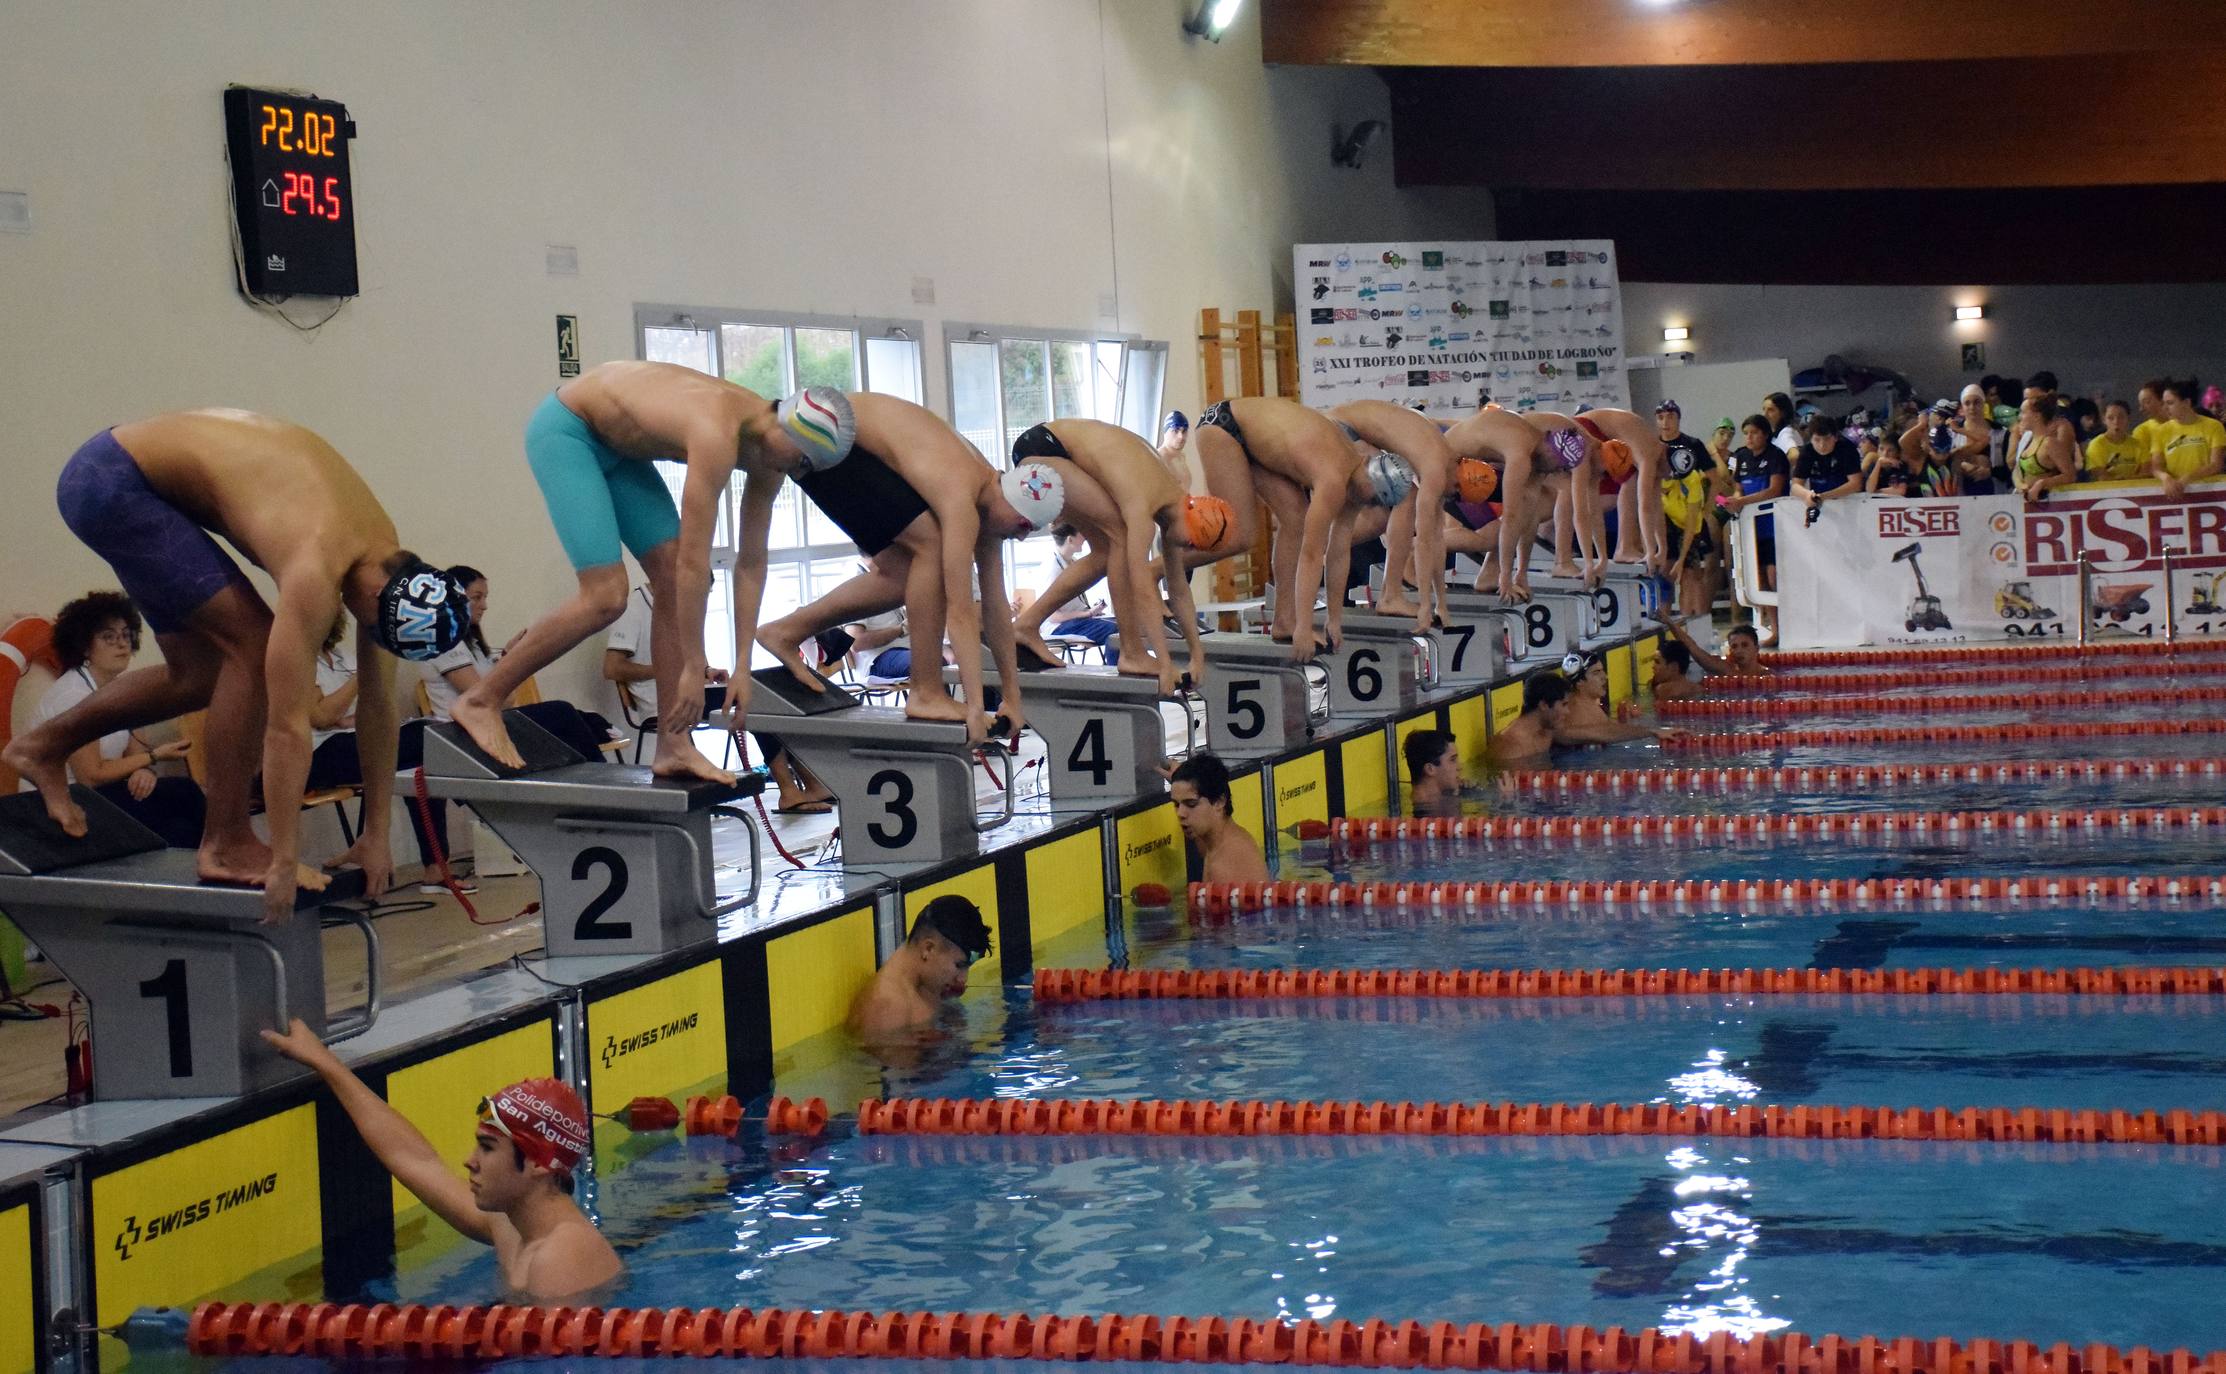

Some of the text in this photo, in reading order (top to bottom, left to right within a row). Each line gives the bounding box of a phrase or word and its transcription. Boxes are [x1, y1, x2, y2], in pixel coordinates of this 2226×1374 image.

[282, 172, 341, 220] 29.5
[1330, 357, 1351, 369] XXI
[1353, 355, 1406, 368] TROFEO
[1408, 354, 1425, 365] DE
[1428, 350, 1487, 364] NATACIÓN
[1538, 349, 1554, 360] DE
[1879, 510, 1960, 534] RISER
[2025, 506, 2226, 563] RISER
[1525, 605, 1553, 648] 8
[1592, 588, 1618, 627] 9
[1443, 625, 1476, 672] 7
[1347, 649, 1383, 701] 6
[1227, 680, 1266, 739] 5
[1068, 719, 1113, 785] 4
[866, 769, 918, 849] 3
[570, 846, 633, 940] 2
[139, 958, 193, 1078] 1
[618, 1012, 698, 1057] SWISS TIMING
[497, 1097, 530, 1123] San
[144, 1173, 278, 1242] SWISS TIMING
